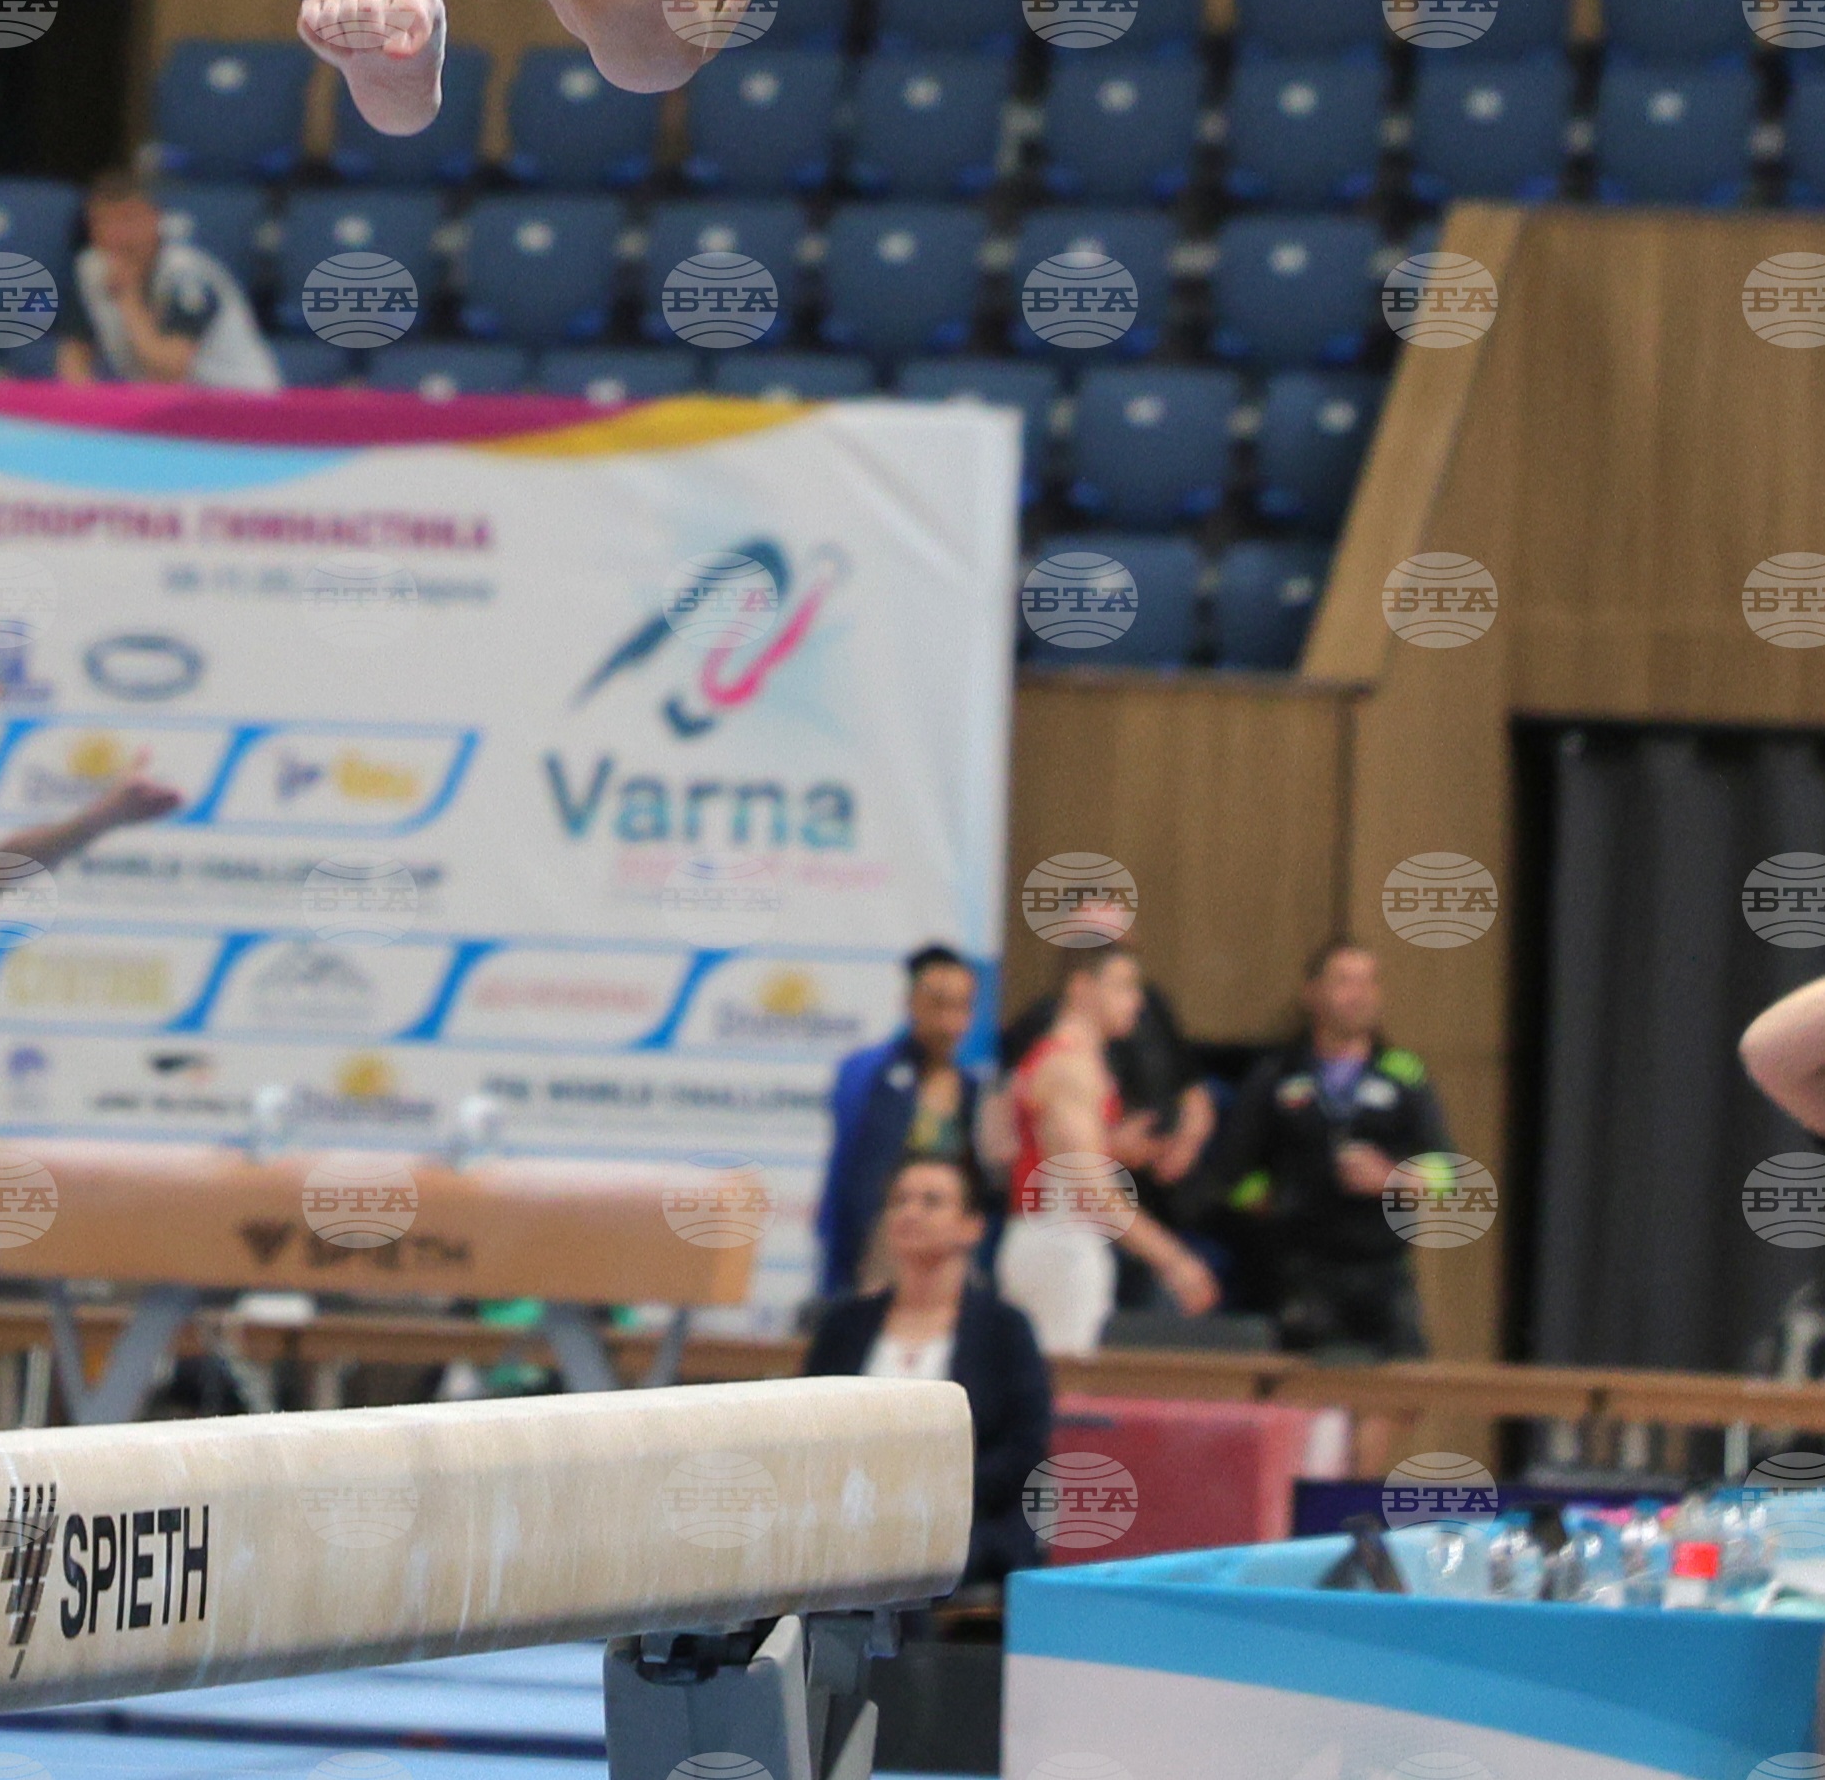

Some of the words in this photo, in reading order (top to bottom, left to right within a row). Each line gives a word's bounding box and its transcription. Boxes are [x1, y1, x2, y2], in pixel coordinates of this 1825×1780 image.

[199, 505, 493, 551] ГИМНАСТИКА
[542, 749, 856, 852] Varna
[60, 1504, 209, 1640] SPIETH
